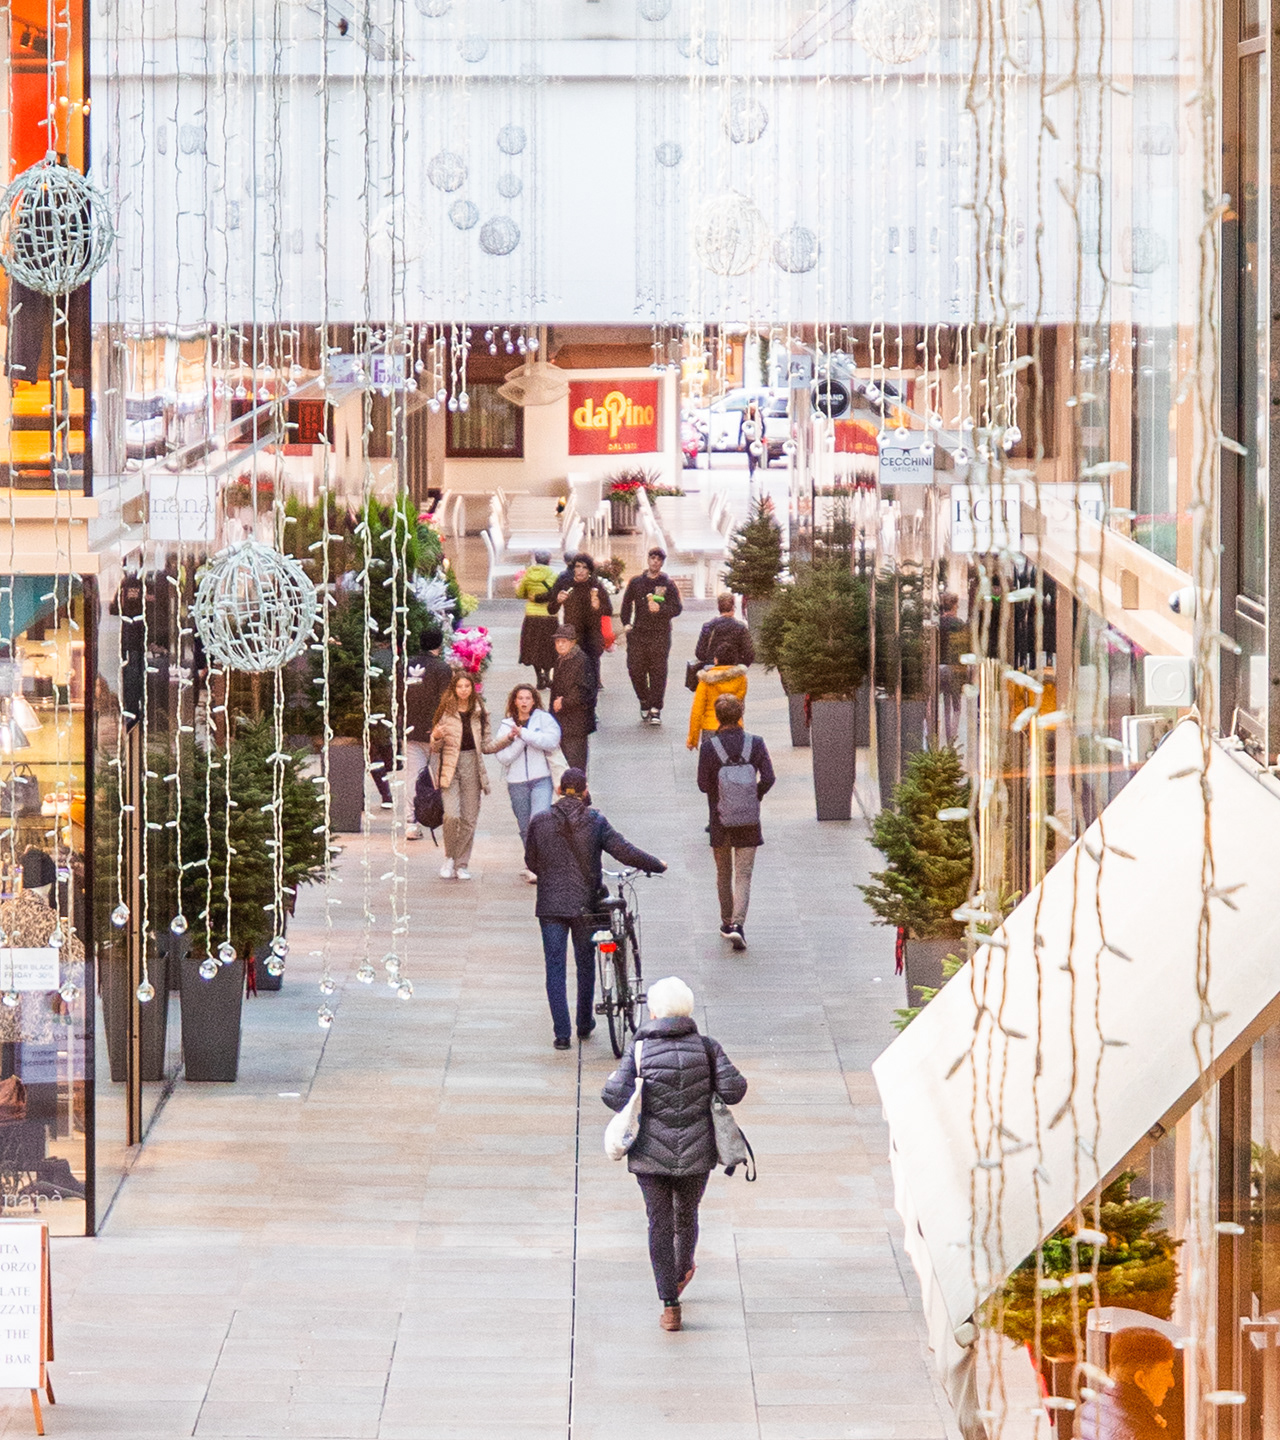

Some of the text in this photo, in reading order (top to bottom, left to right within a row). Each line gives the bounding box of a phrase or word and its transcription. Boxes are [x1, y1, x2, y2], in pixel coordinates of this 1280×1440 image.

[880, 457, 933, 467] CECCHINI
[0, 1262, 37, 1272] ORZO
[6, 1329, 30, 1339] THE
[5, 1355, 32, 1364] BAR
